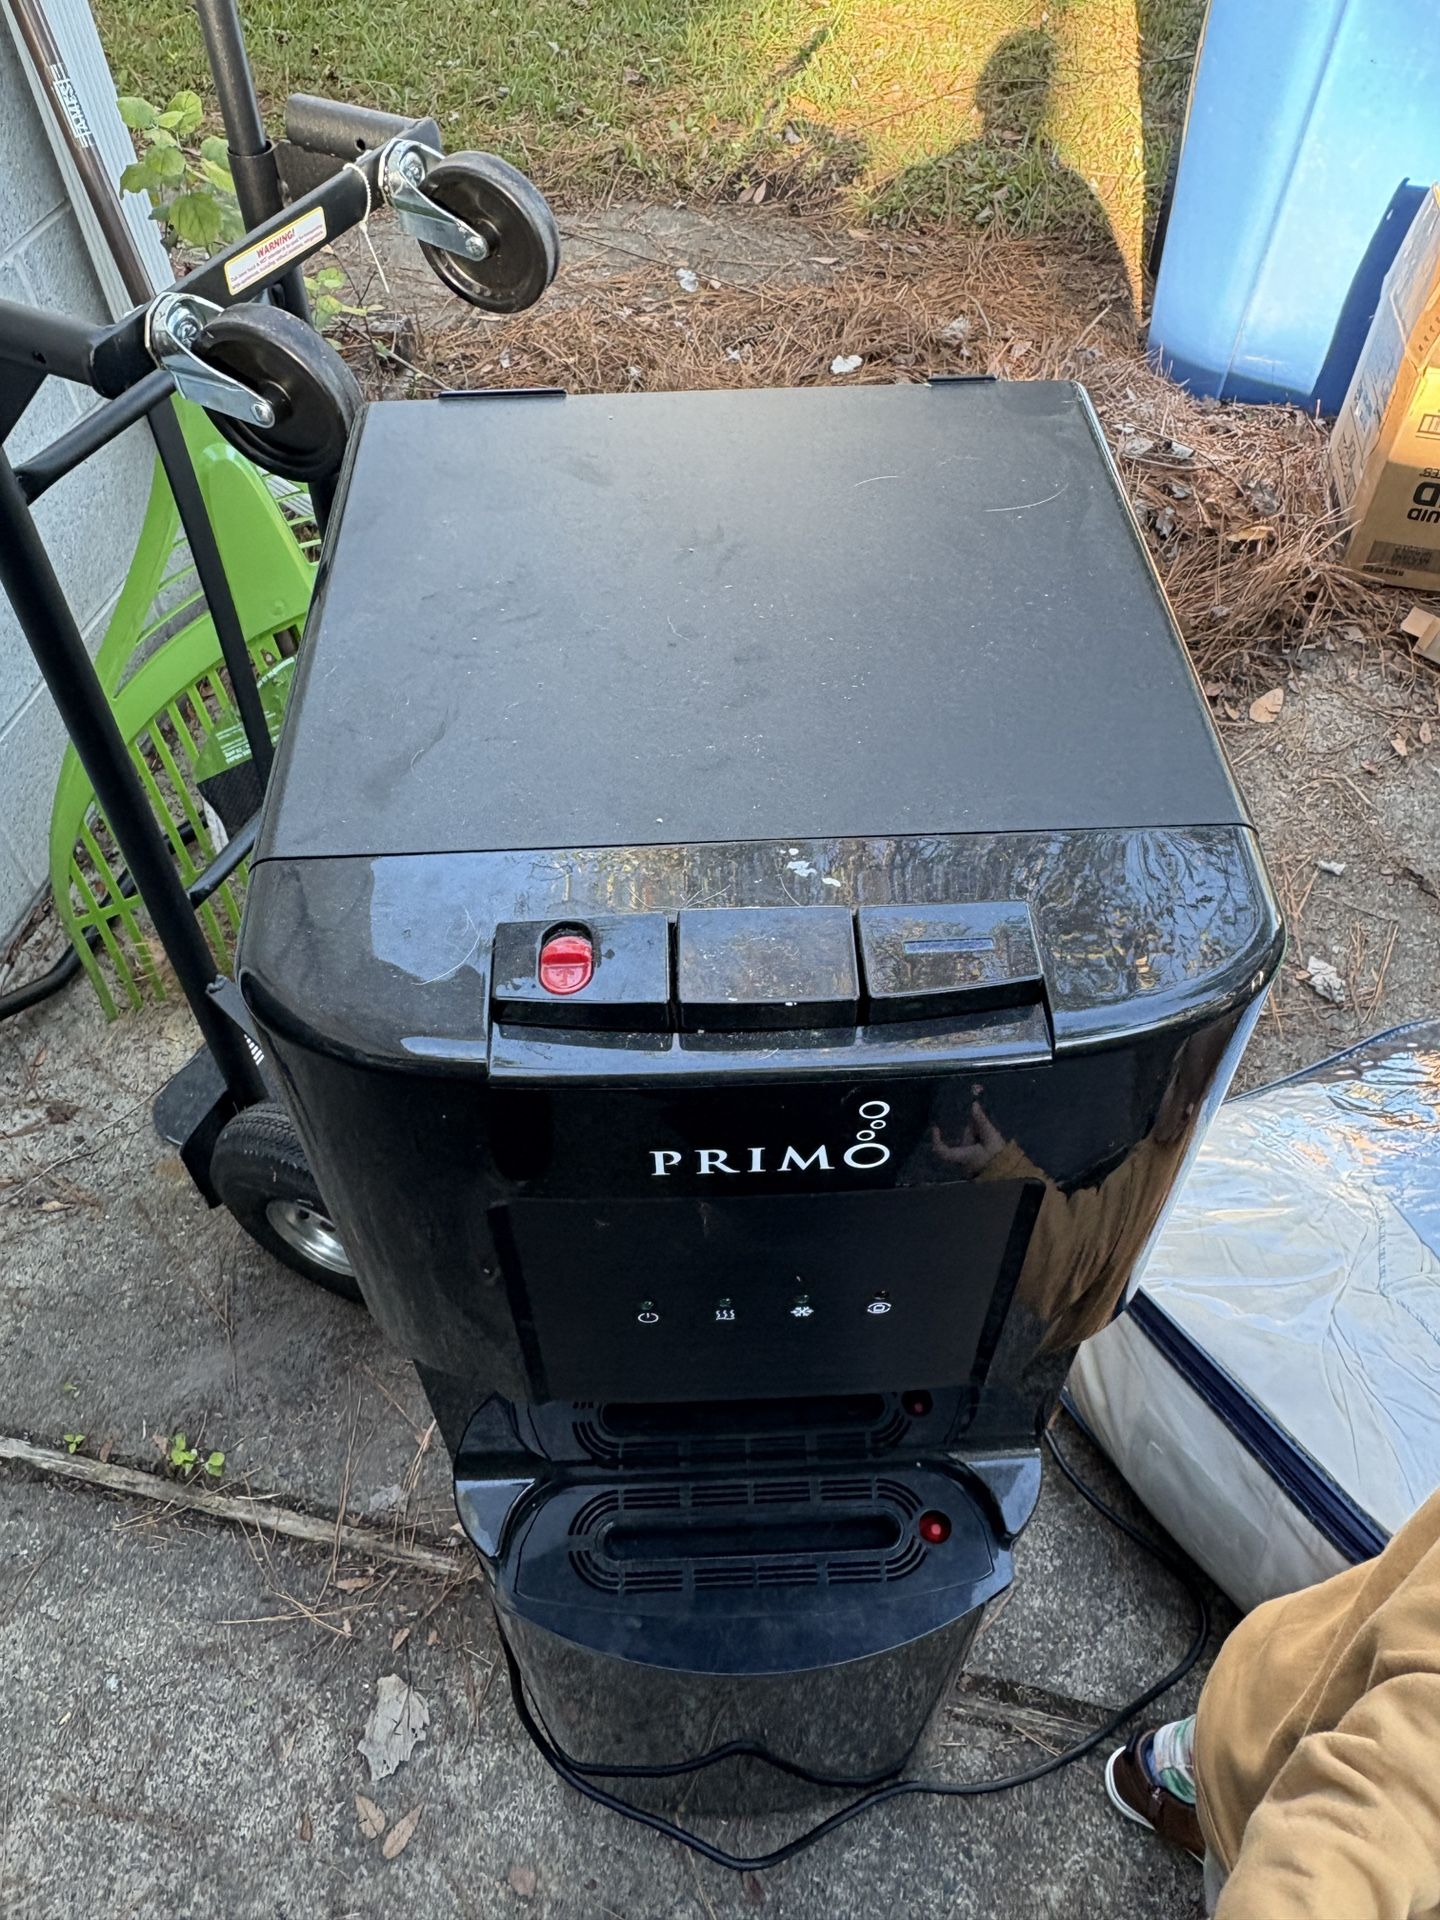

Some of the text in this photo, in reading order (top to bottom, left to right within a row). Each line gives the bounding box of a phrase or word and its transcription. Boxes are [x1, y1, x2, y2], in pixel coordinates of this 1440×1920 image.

[60, 81, 90, 133] AMES
[256, 228, 295, 258] WARNING!
[1406, 508, 1440, 524] UID
[649, 1142, 890, 1176] PRIMO
